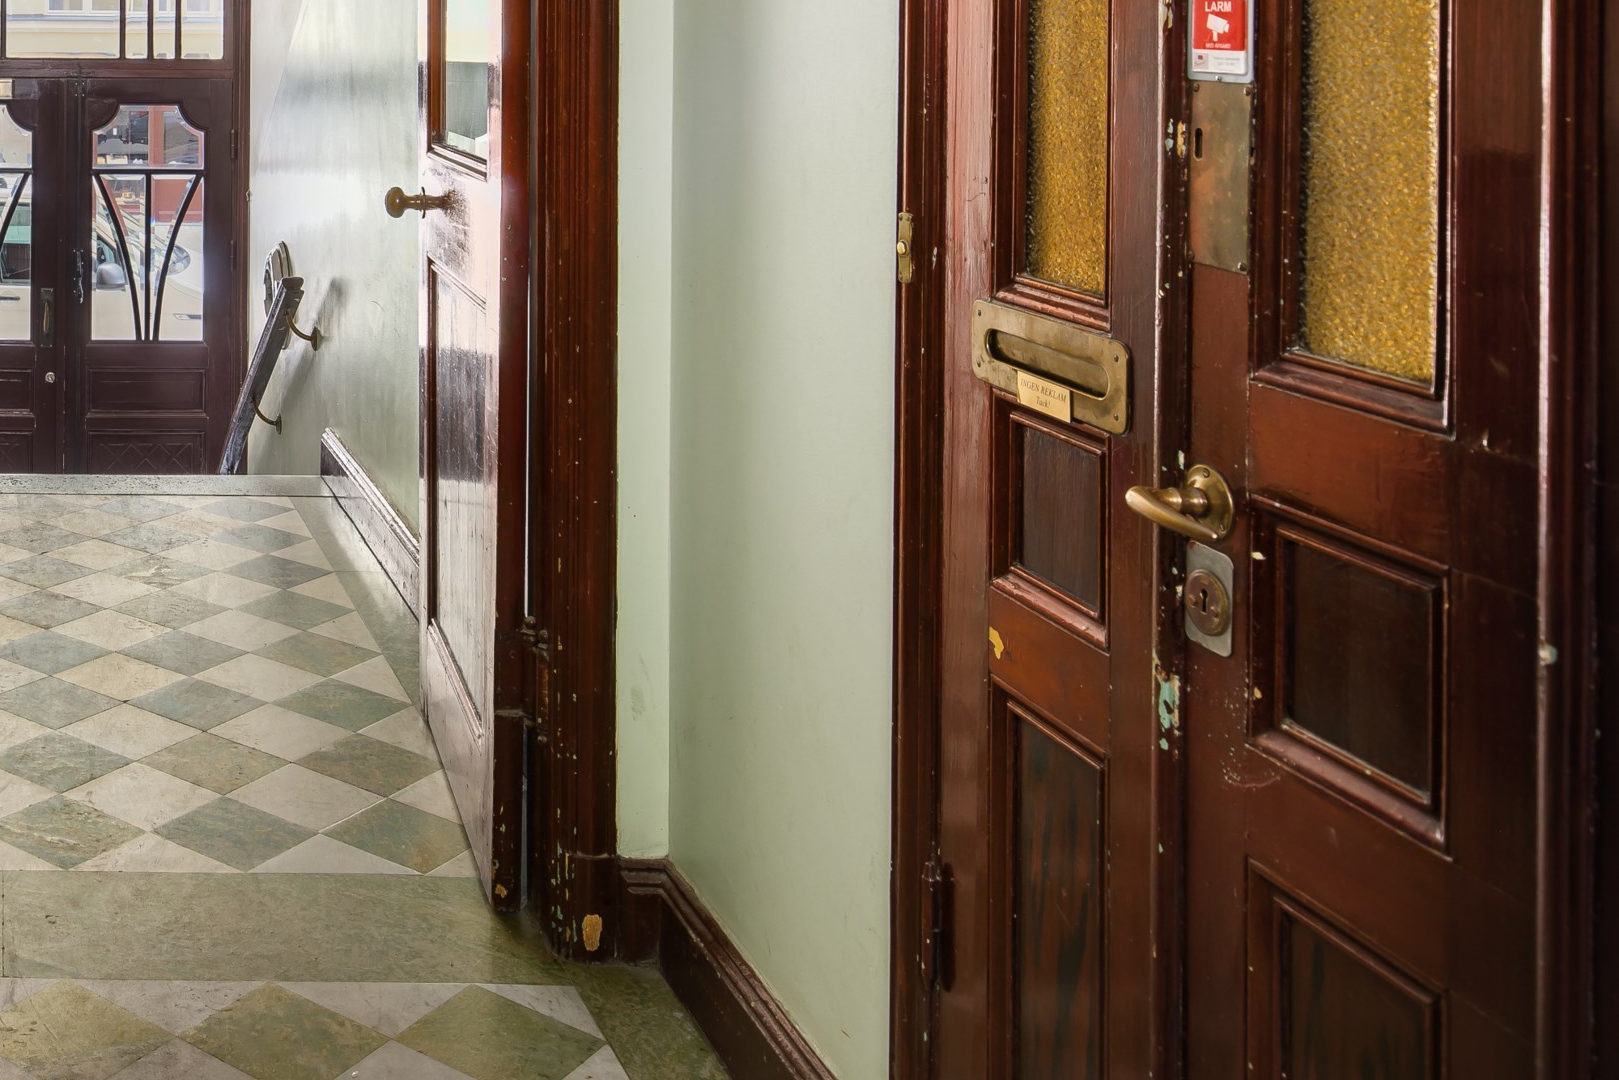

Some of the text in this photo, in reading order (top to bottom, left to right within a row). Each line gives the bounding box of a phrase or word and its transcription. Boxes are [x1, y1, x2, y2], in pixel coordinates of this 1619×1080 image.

[1204, 0, 1232, 13] LARM
[1021, 378, 1067, 403] INGEN REKLAM
